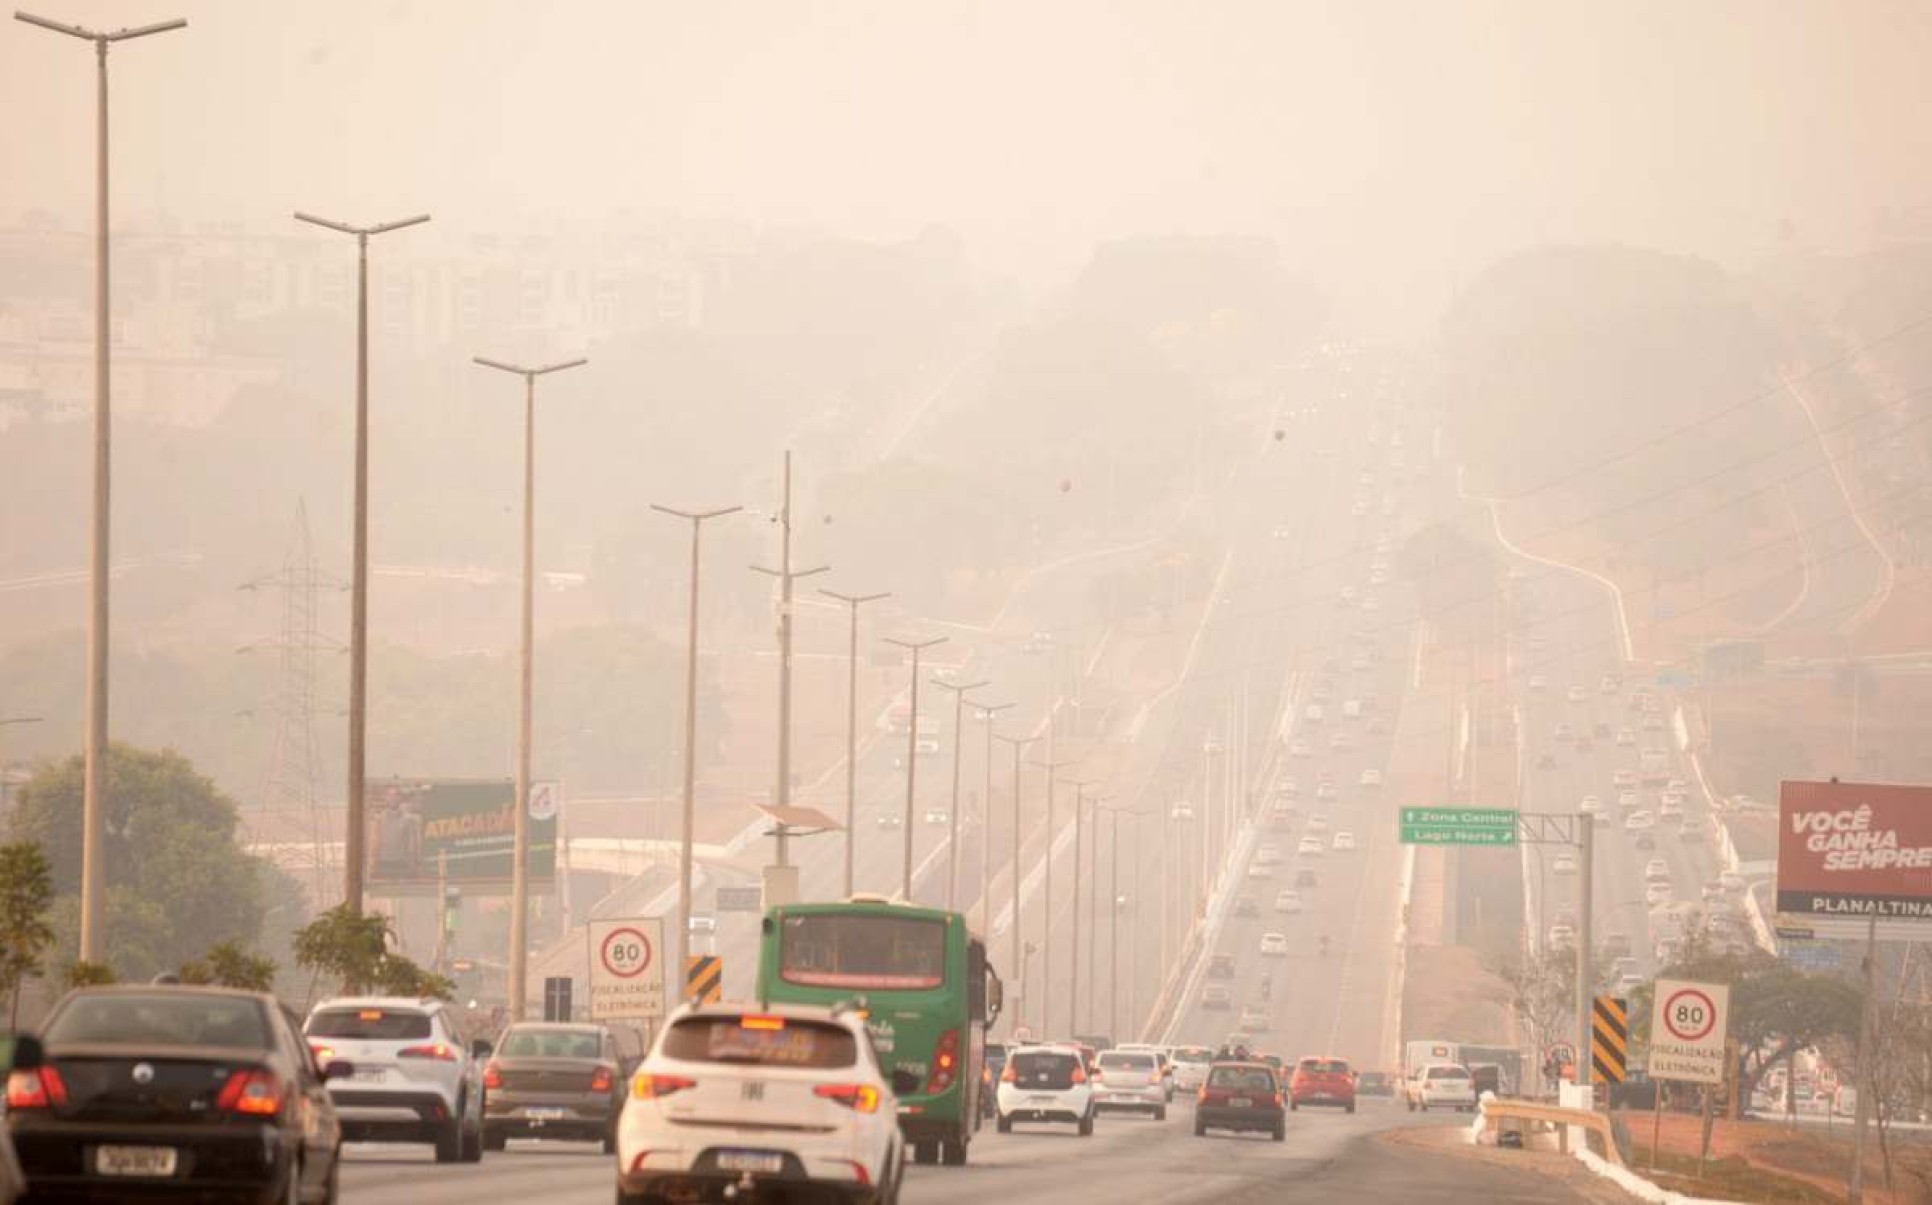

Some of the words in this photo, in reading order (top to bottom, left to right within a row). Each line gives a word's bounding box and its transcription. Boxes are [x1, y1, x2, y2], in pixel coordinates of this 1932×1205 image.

[1420, 811, 1457, 822] Zona
[1461, 812, 1513, 823] Central
[1792, 804, 1873, 834] VOCÊ
[1415, 831, 1451, 842] Lago
[1455, 832, 1495, 841] Norte
[1807, 829, 1897, 851] GANHA
[1823, 847, 1932, 870] SEMPRE
[613, 943, 640, 961] 80
[597, 998, 656, 1012] ELETRÔNICA
[1676, 1005, 1703, 1024] 80
[1651, 1043, 1724, 1059] FISCALIZAÇÃO
[1655, 1060, 1716, 1076] ELETRÔNICA
